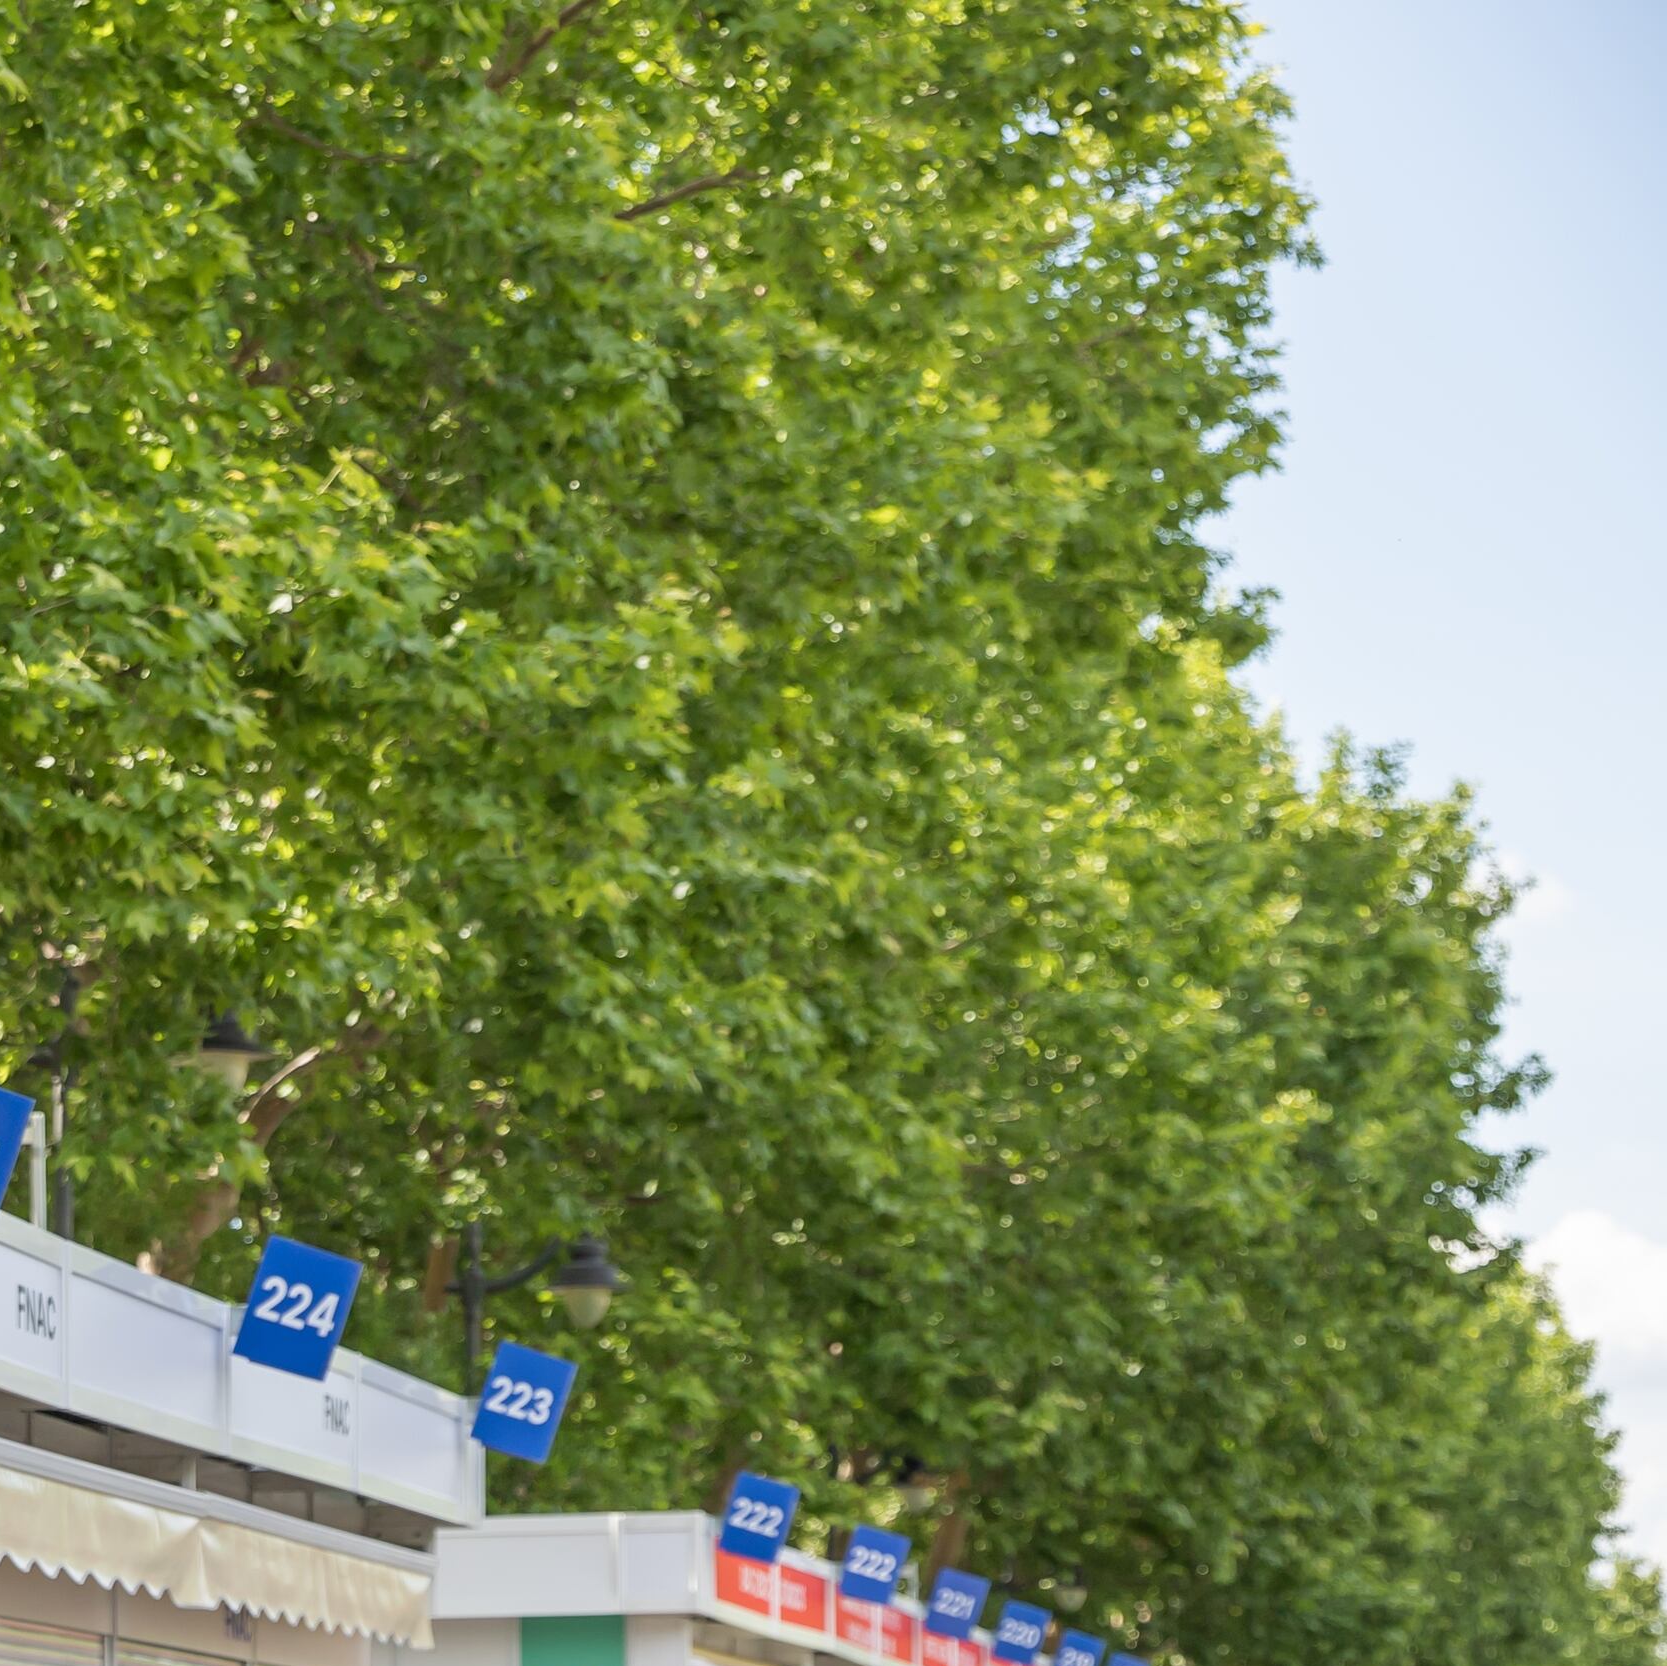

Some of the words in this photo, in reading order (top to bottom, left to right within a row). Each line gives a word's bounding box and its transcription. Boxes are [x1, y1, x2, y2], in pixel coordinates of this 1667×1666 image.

[17, 1284, 57, 1341] FNAC
[253, 1275, 341, 1337] 224
[484, 1375, 555, 1426] 223
[727, 1496, 785, 1539] 222
[846, 1545, 898, 1584] 222
[934, 1586, 977, 1622] 221
[999, 1616, 1042, 1650] 220
